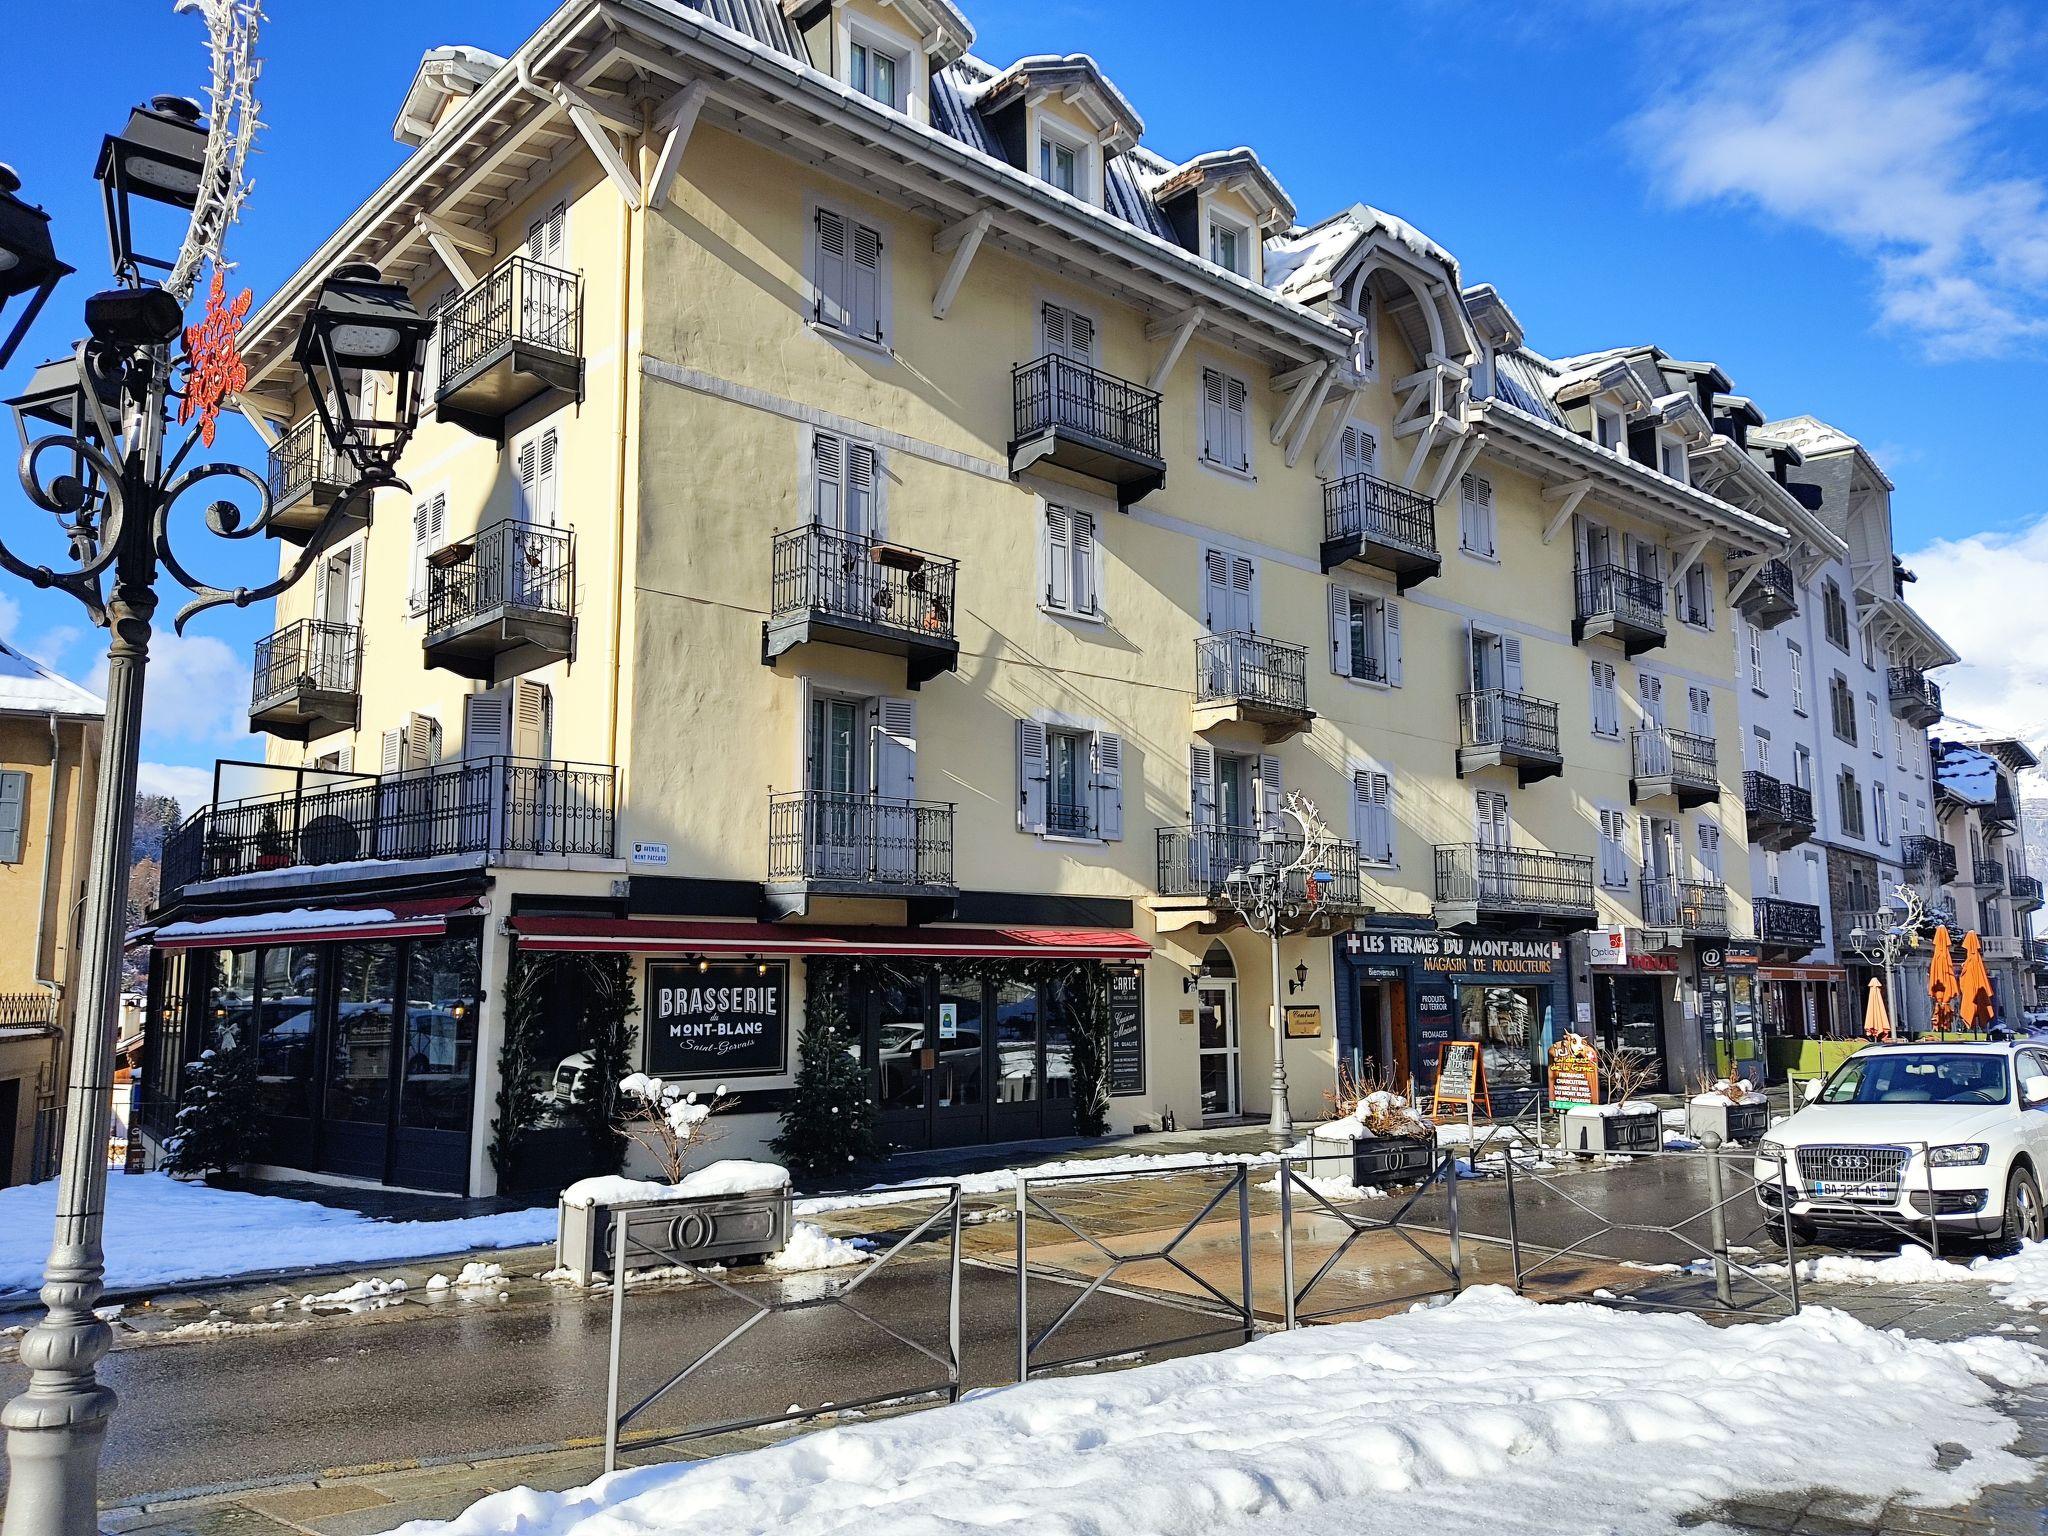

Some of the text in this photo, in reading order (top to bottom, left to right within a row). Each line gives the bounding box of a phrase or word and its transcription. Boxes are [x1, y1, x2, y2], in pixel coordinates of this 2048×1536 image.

[1362, 935, 1550, 958] LES FERMES DU MONT-BLANC
[1423, 956, 1552, 973] MAGASIN DE PRODUCTEURS
[1368, 967, 1395, 977] Bienvenue
[1113, 976, 1136, 990] CARTE
[659, 987, 777, 1018] BRASSERIE
[1421, 995, 1445, 1003] PRODUITS
[1420, 1003, 1448, 1011] DU TERROIR
[709, 1012, 719, 1021] du
[669, 1022, 763, 1037] MONT-BLANC
[1422, 1030, 1448, 1039] FROMAGES
[1556, 1078, 1589, 1086] CHARCUTERIE
